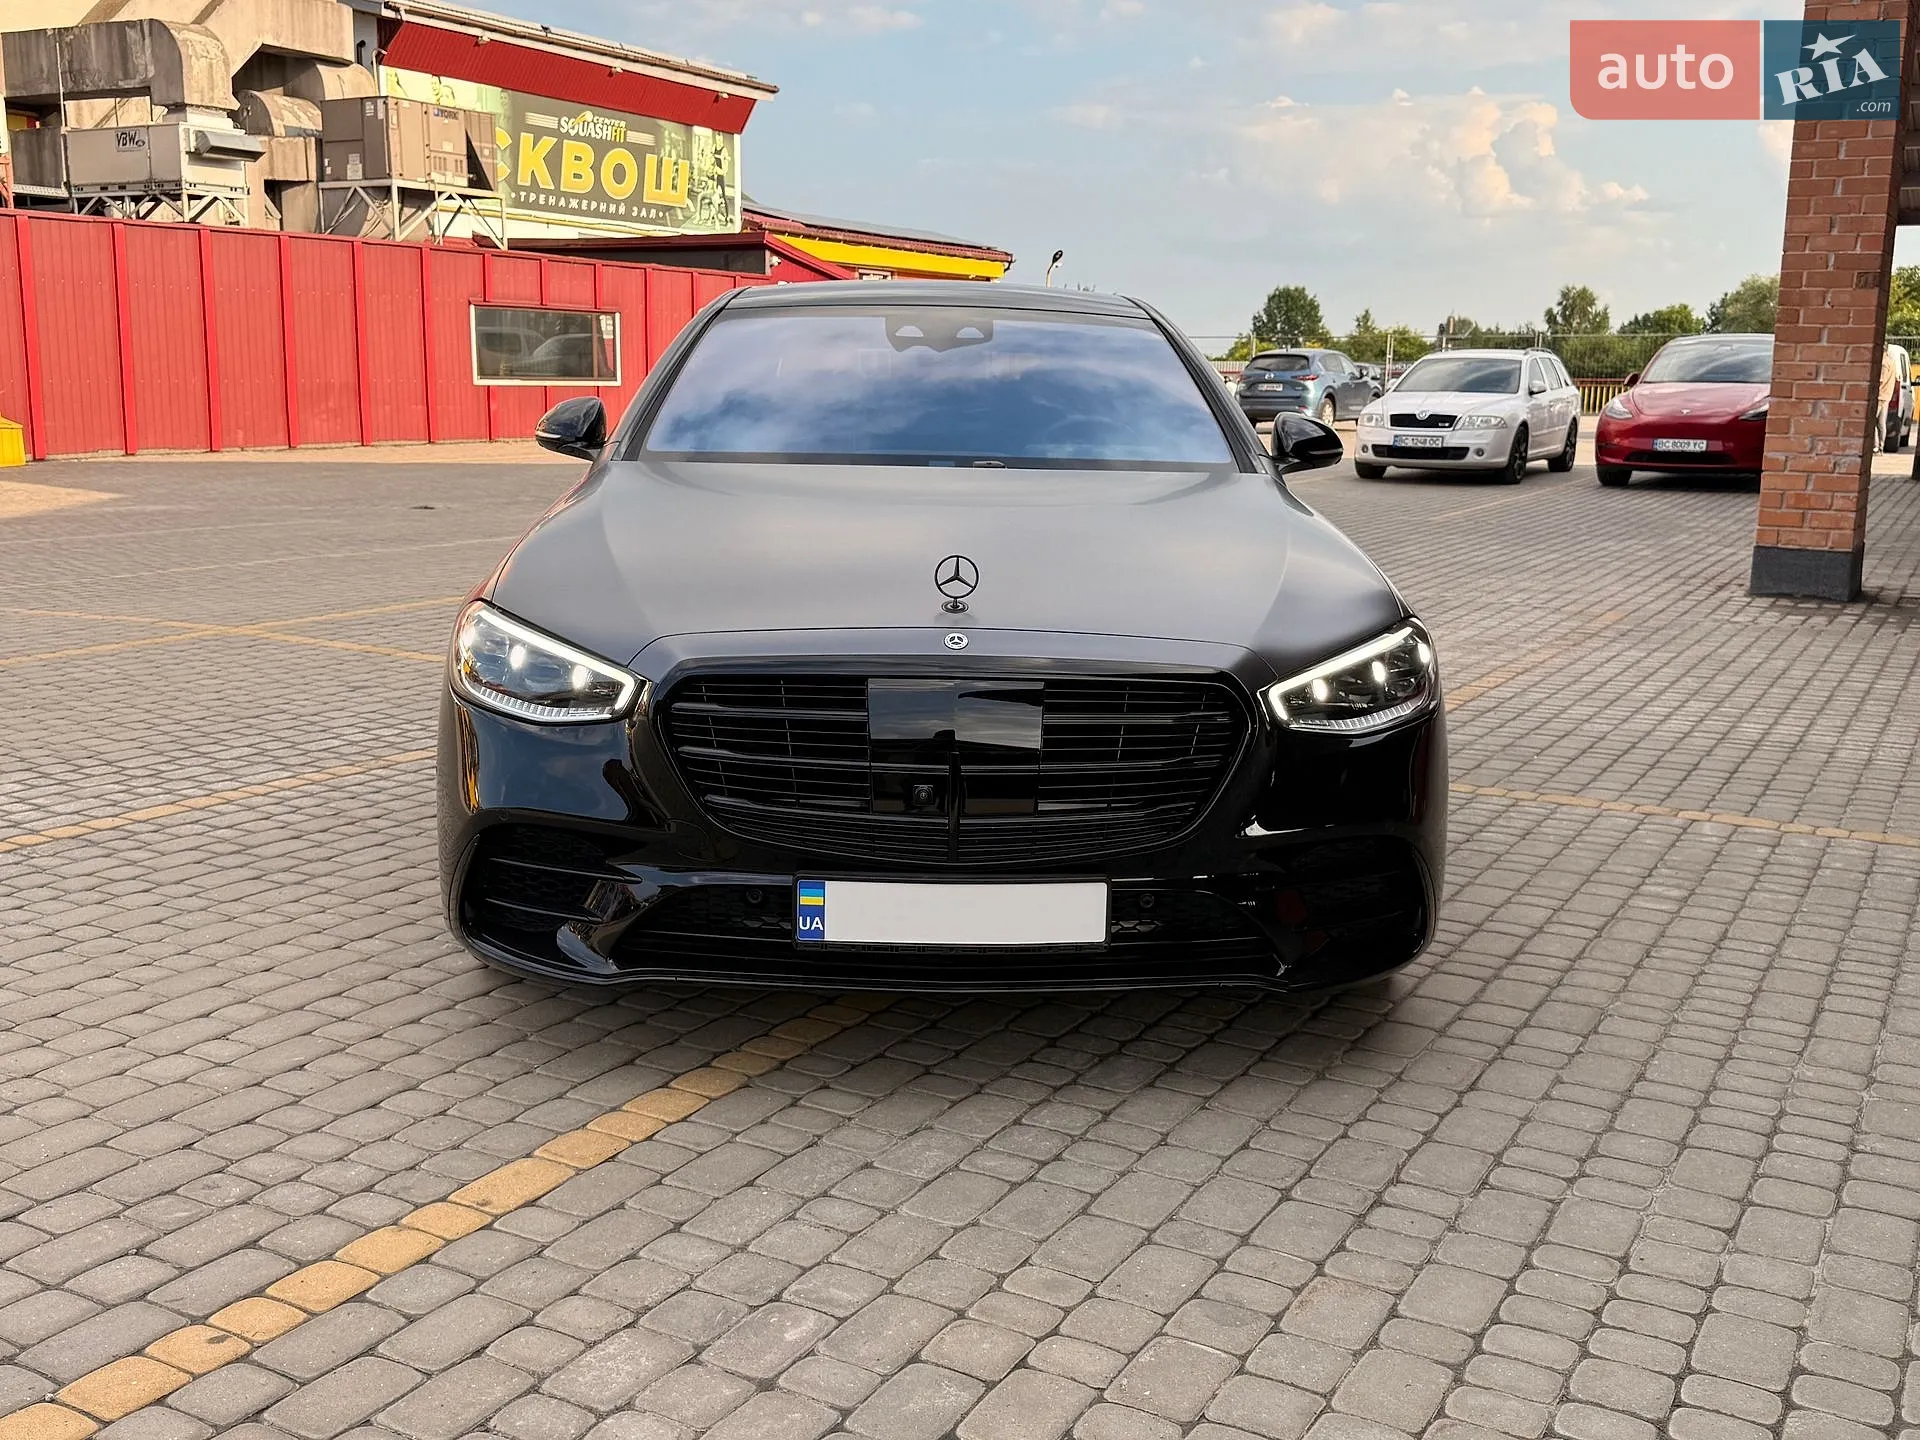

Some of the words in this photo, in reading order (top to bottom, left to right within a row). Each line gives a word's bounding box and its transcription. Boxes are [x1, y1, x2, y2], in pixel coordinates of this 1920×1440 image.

[519, 191, 626, 215] ТРЕНАЖЕРНИЙ
[631, 206, 657, 219] ЗАЛ
[799, 916, 824, 931] UA
